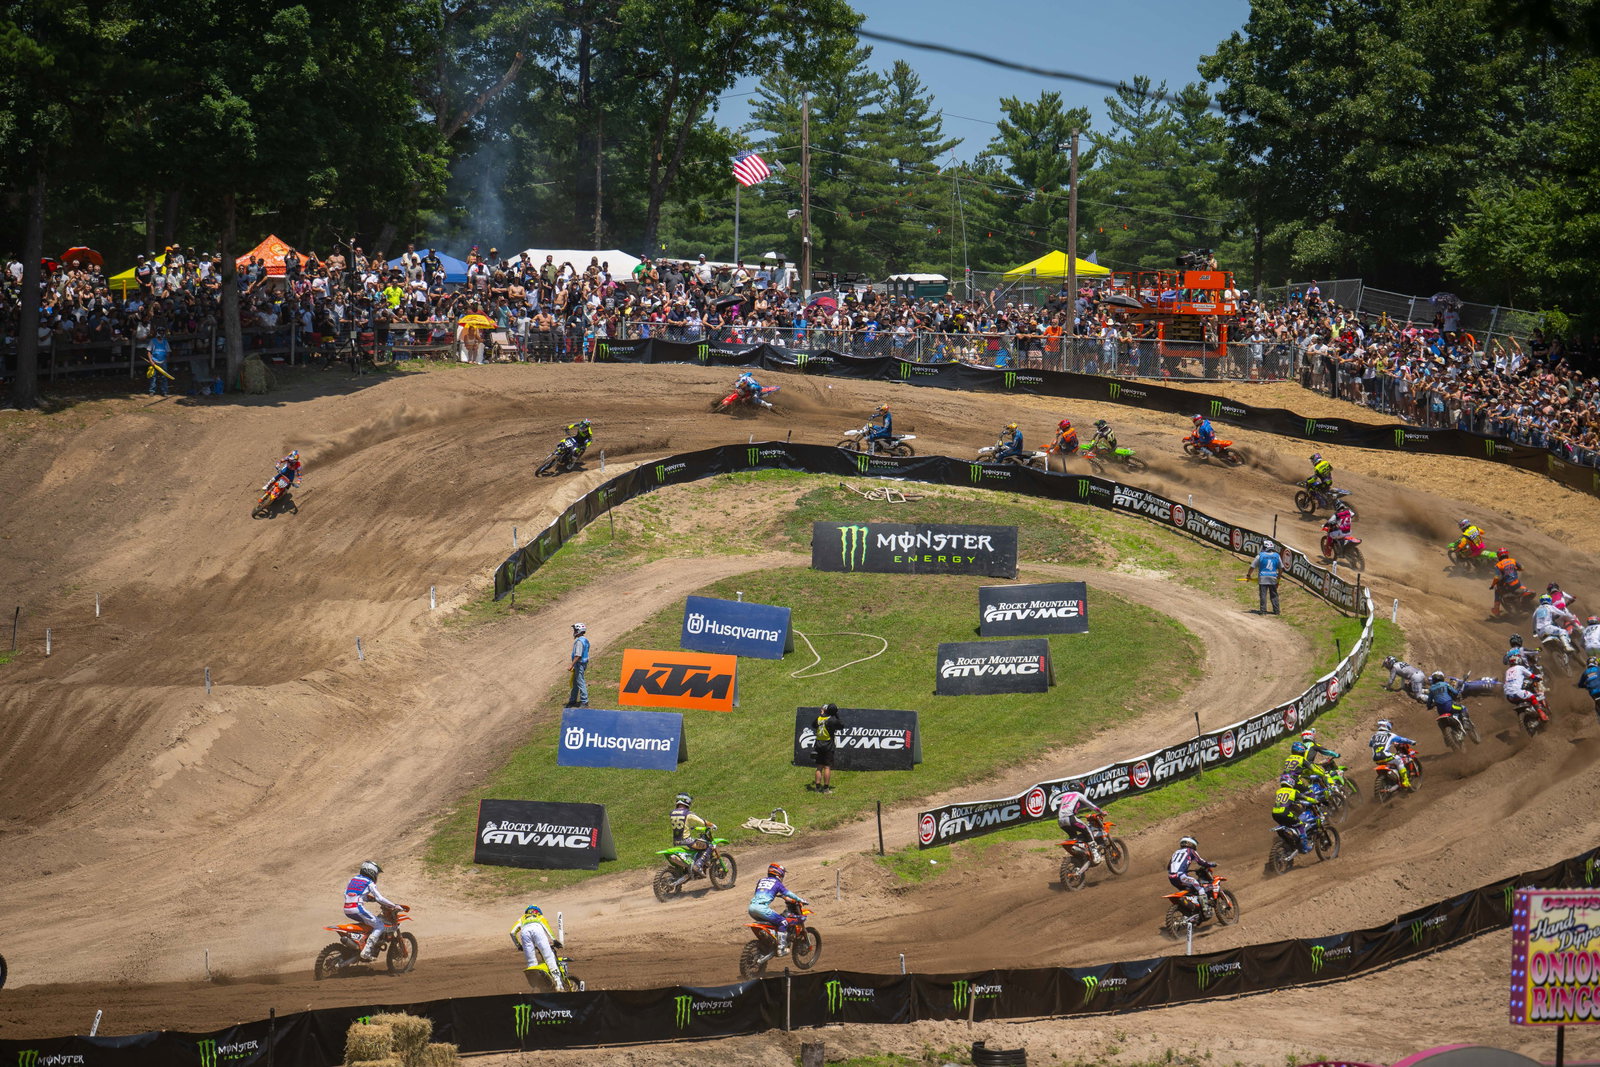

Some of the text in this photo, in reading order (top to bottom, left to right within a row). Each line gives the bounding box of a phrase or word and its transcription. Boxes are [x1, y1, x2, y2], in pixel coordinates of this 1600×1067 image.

[1122, 487, 1144, 501] ROCKY
[877, 530, 995, 553] MONSTER
[893, 555, 976, 564] ENERGY
[998, 600, 1079, 611] ROCKY MOUNTAIN
[704, 619, 779, 643] Husqvarna
[956, 655, 1039, 666] ROCKY MOUNTAIN
[622, 662, 733, 700] KTM
[850, 727, 906, 737] MOUNTAIN
[585, 732, 671, 752] Husqvarna
[1165, 746, 1188, 763] ROCKY
[1087, 765, 1129, 785] MOUNTAIN
[951, 807, 973, 819] ROCKY
[499, 820, 592, 836] ROCKY MOUNTAIN
[1531, 908, 1575, 942] Hand
[531, 1008, 573, 1019] MONSTER
[217, 1039, 259, 1055] MONSTER
[37, 1053, 85, 1067] MONSTER
